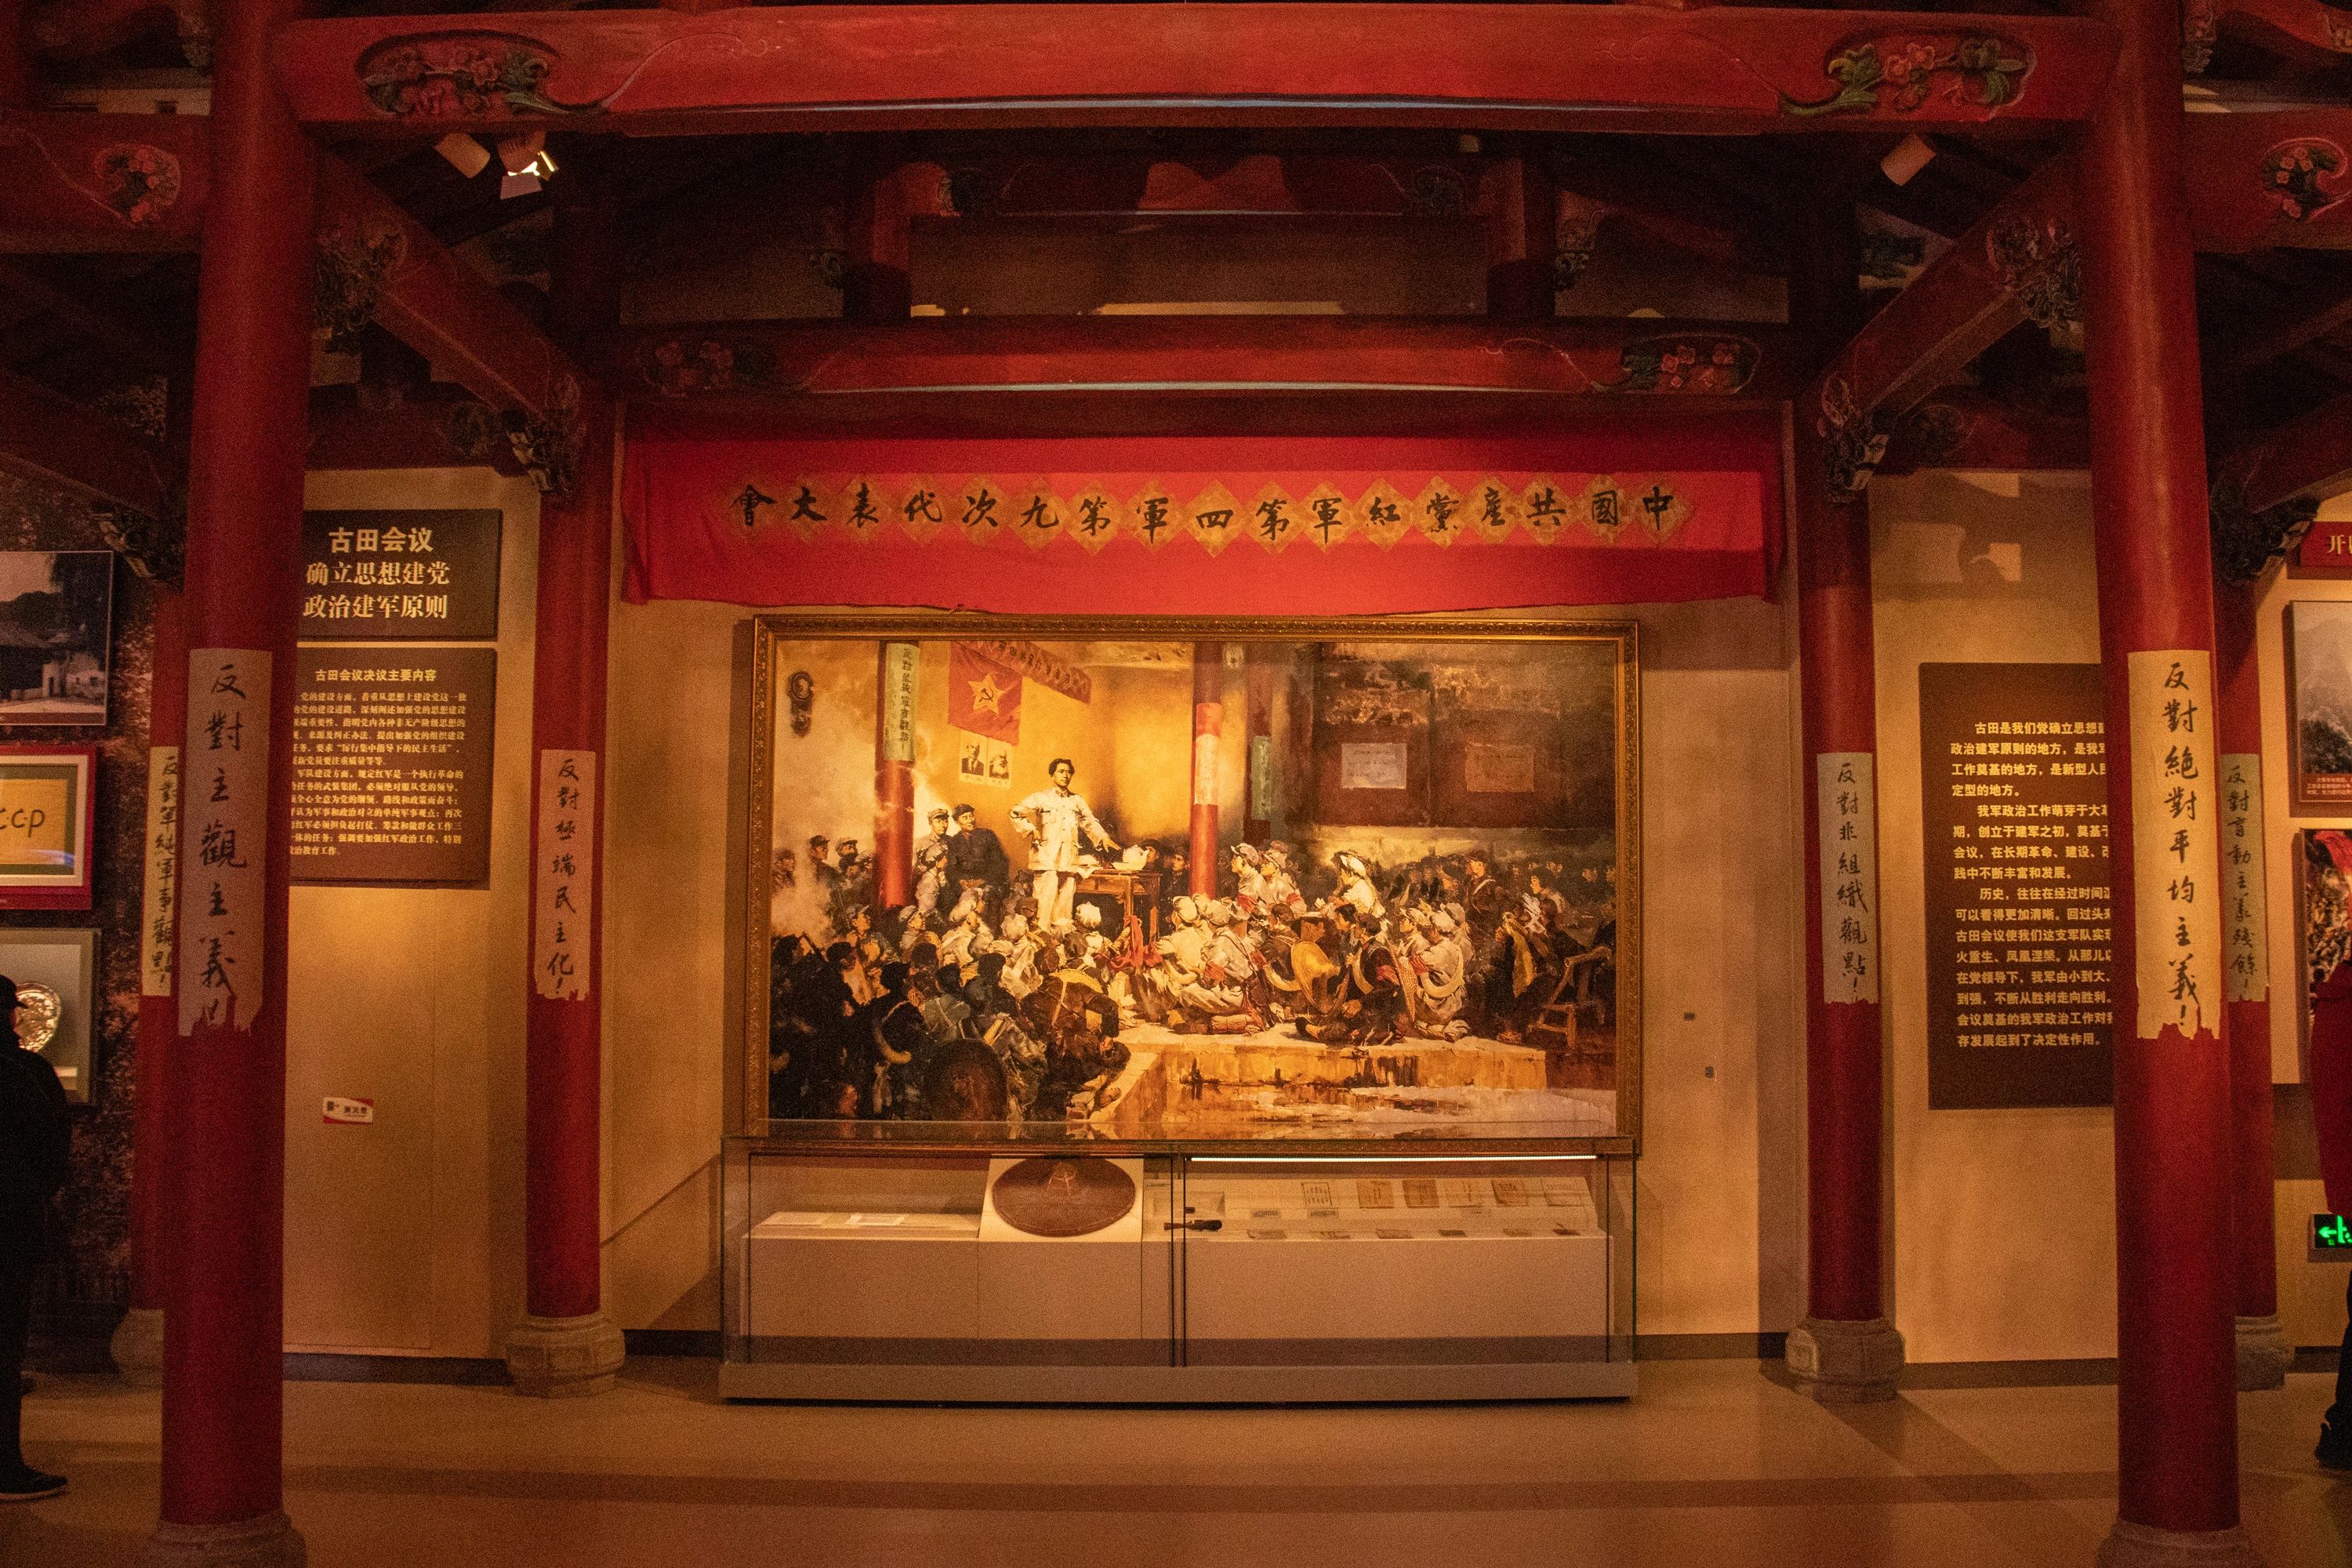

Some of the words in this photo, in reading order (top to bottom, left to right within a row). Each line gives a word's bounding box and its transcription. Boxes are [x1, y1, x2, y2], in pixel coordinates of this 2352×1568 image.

[328, 526, 434, 553] 古田会议
[2327, 534, 2352, 555] 开
[306, 561, 450, 586] 确立思想建党
[303, 594, 448, 619] 政治建军原则
[315, 669, 437, 682] 古田会议决议主要内容
